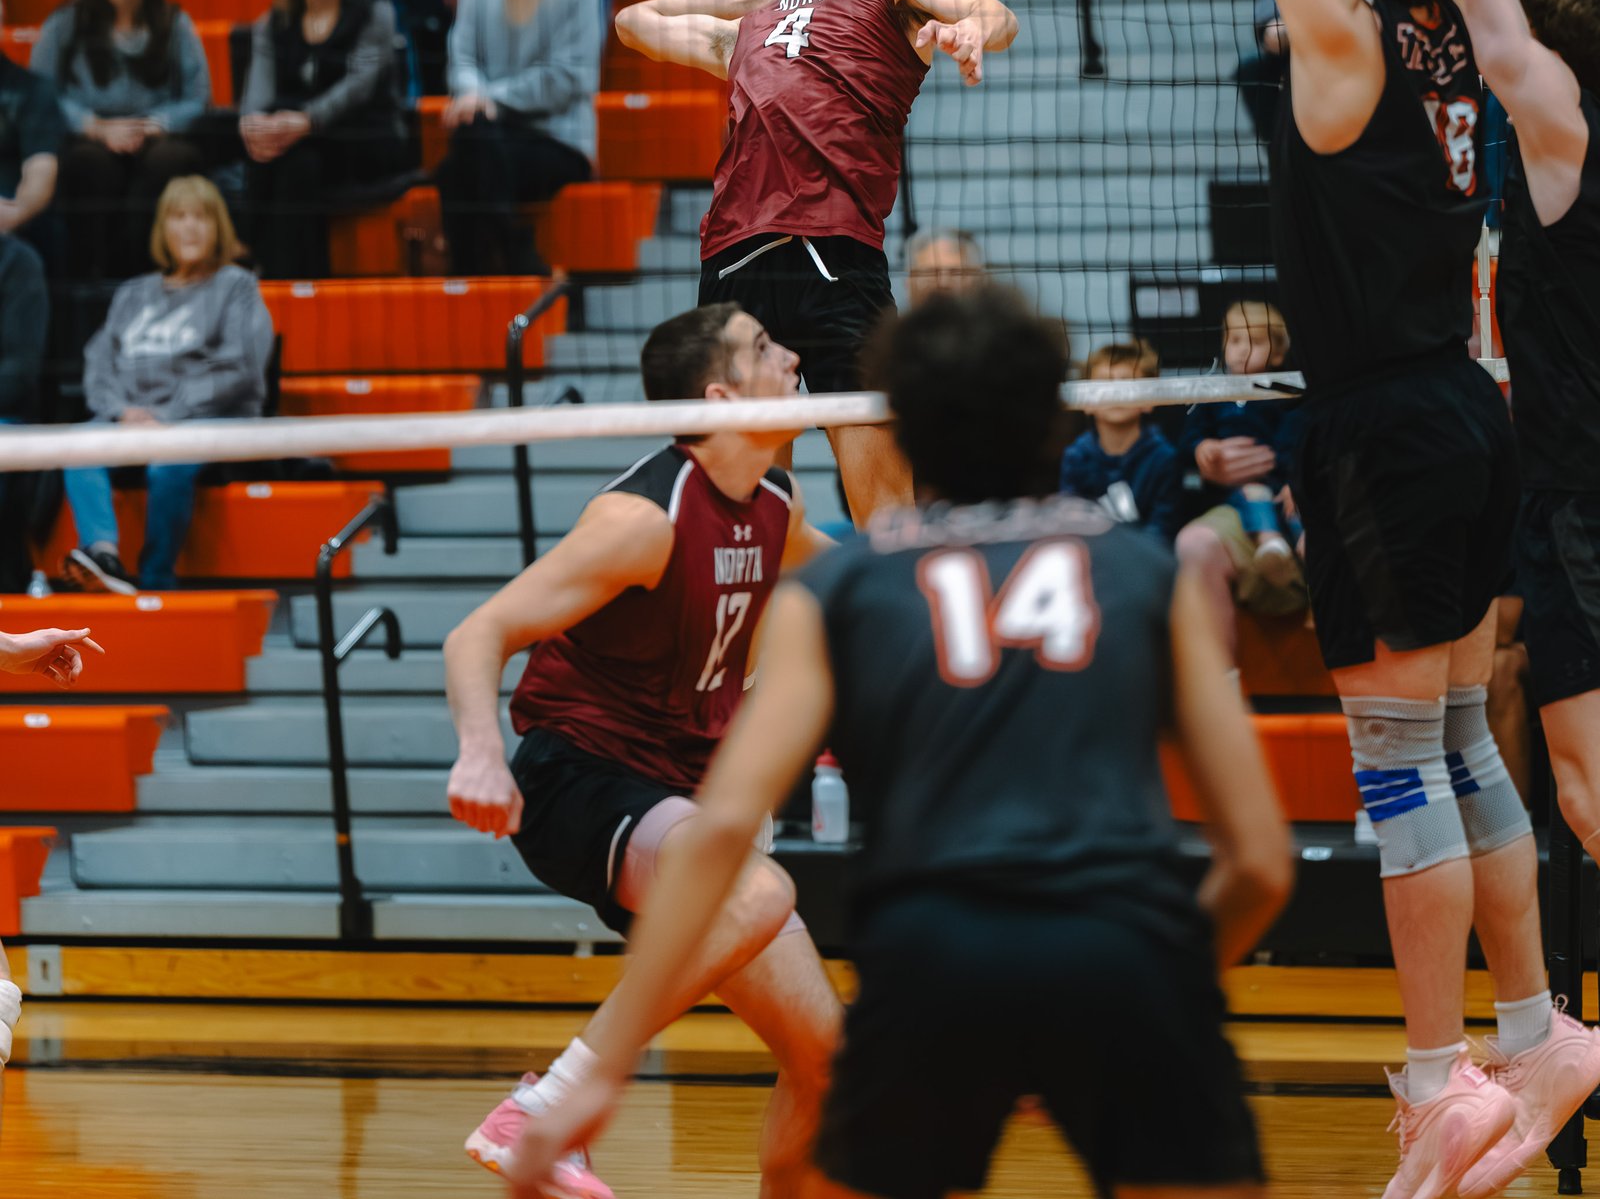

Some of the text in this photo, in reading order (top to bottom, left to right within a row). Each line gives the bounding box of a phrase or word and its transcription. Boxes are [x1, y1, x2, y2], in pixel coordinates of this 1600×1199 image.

[764, 7, 815, 59] 4
[714, 545, 763, 585] NORTH
[916, 535, 1102, 688] 14
